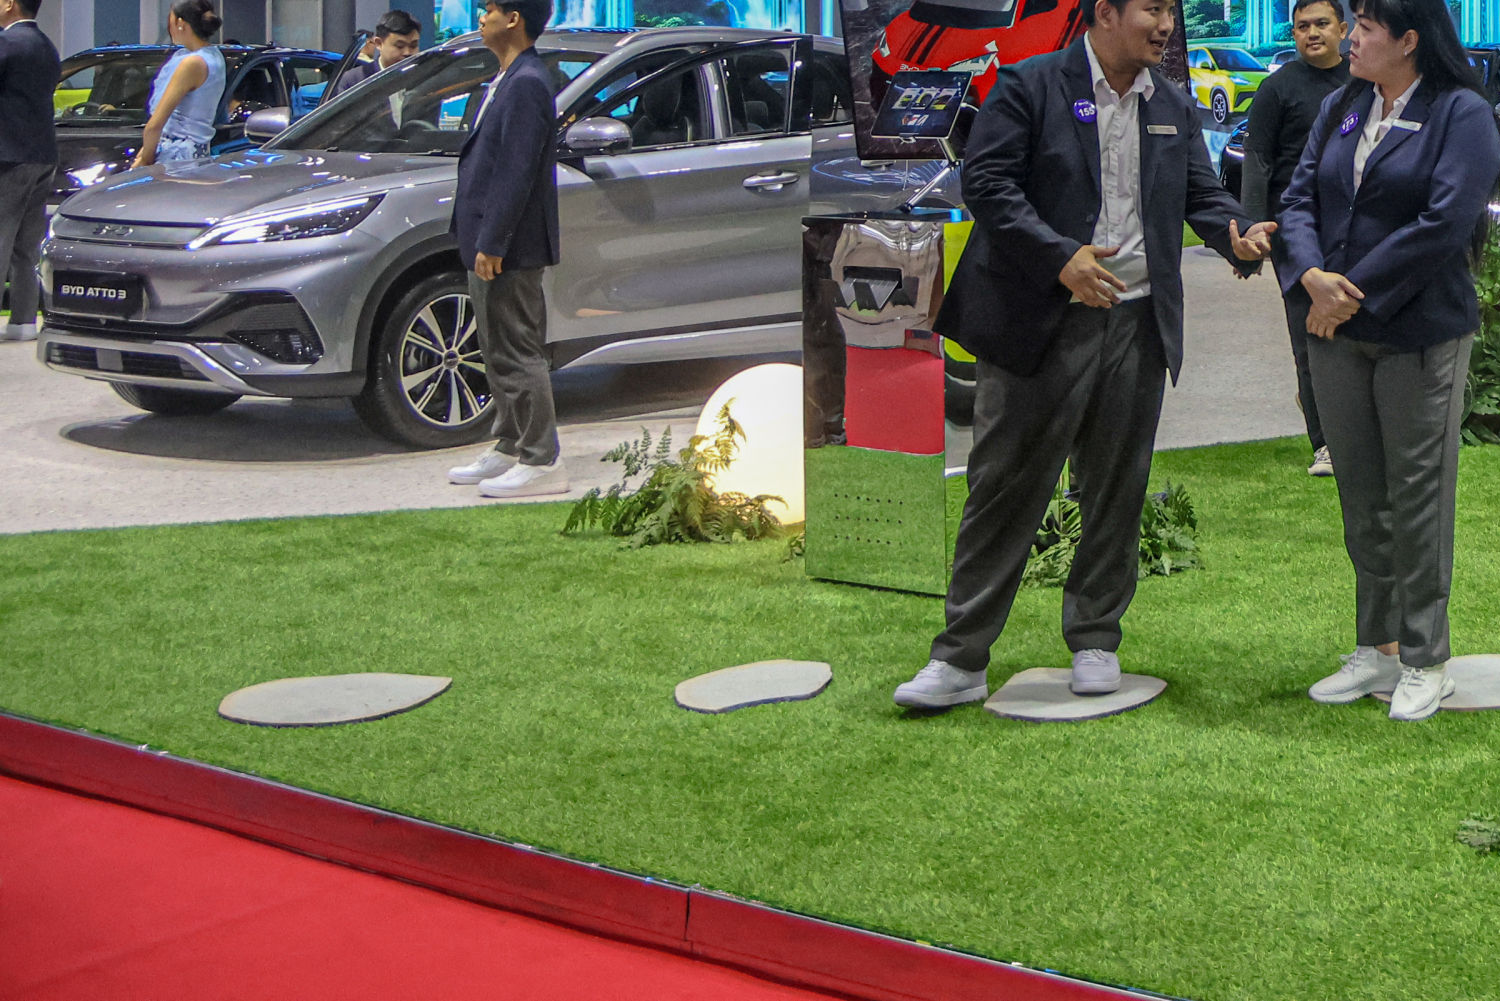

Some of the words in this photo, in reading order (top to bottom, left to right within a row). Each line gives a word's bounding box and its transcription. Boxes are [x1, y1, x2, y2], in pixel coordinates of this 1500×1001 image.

[1079, 107, 1095, 117] 155
[61, 284, 84, 296] BYD
[86, 287, 116, 298] ATTO
[118, 289, 127, 299] 3
